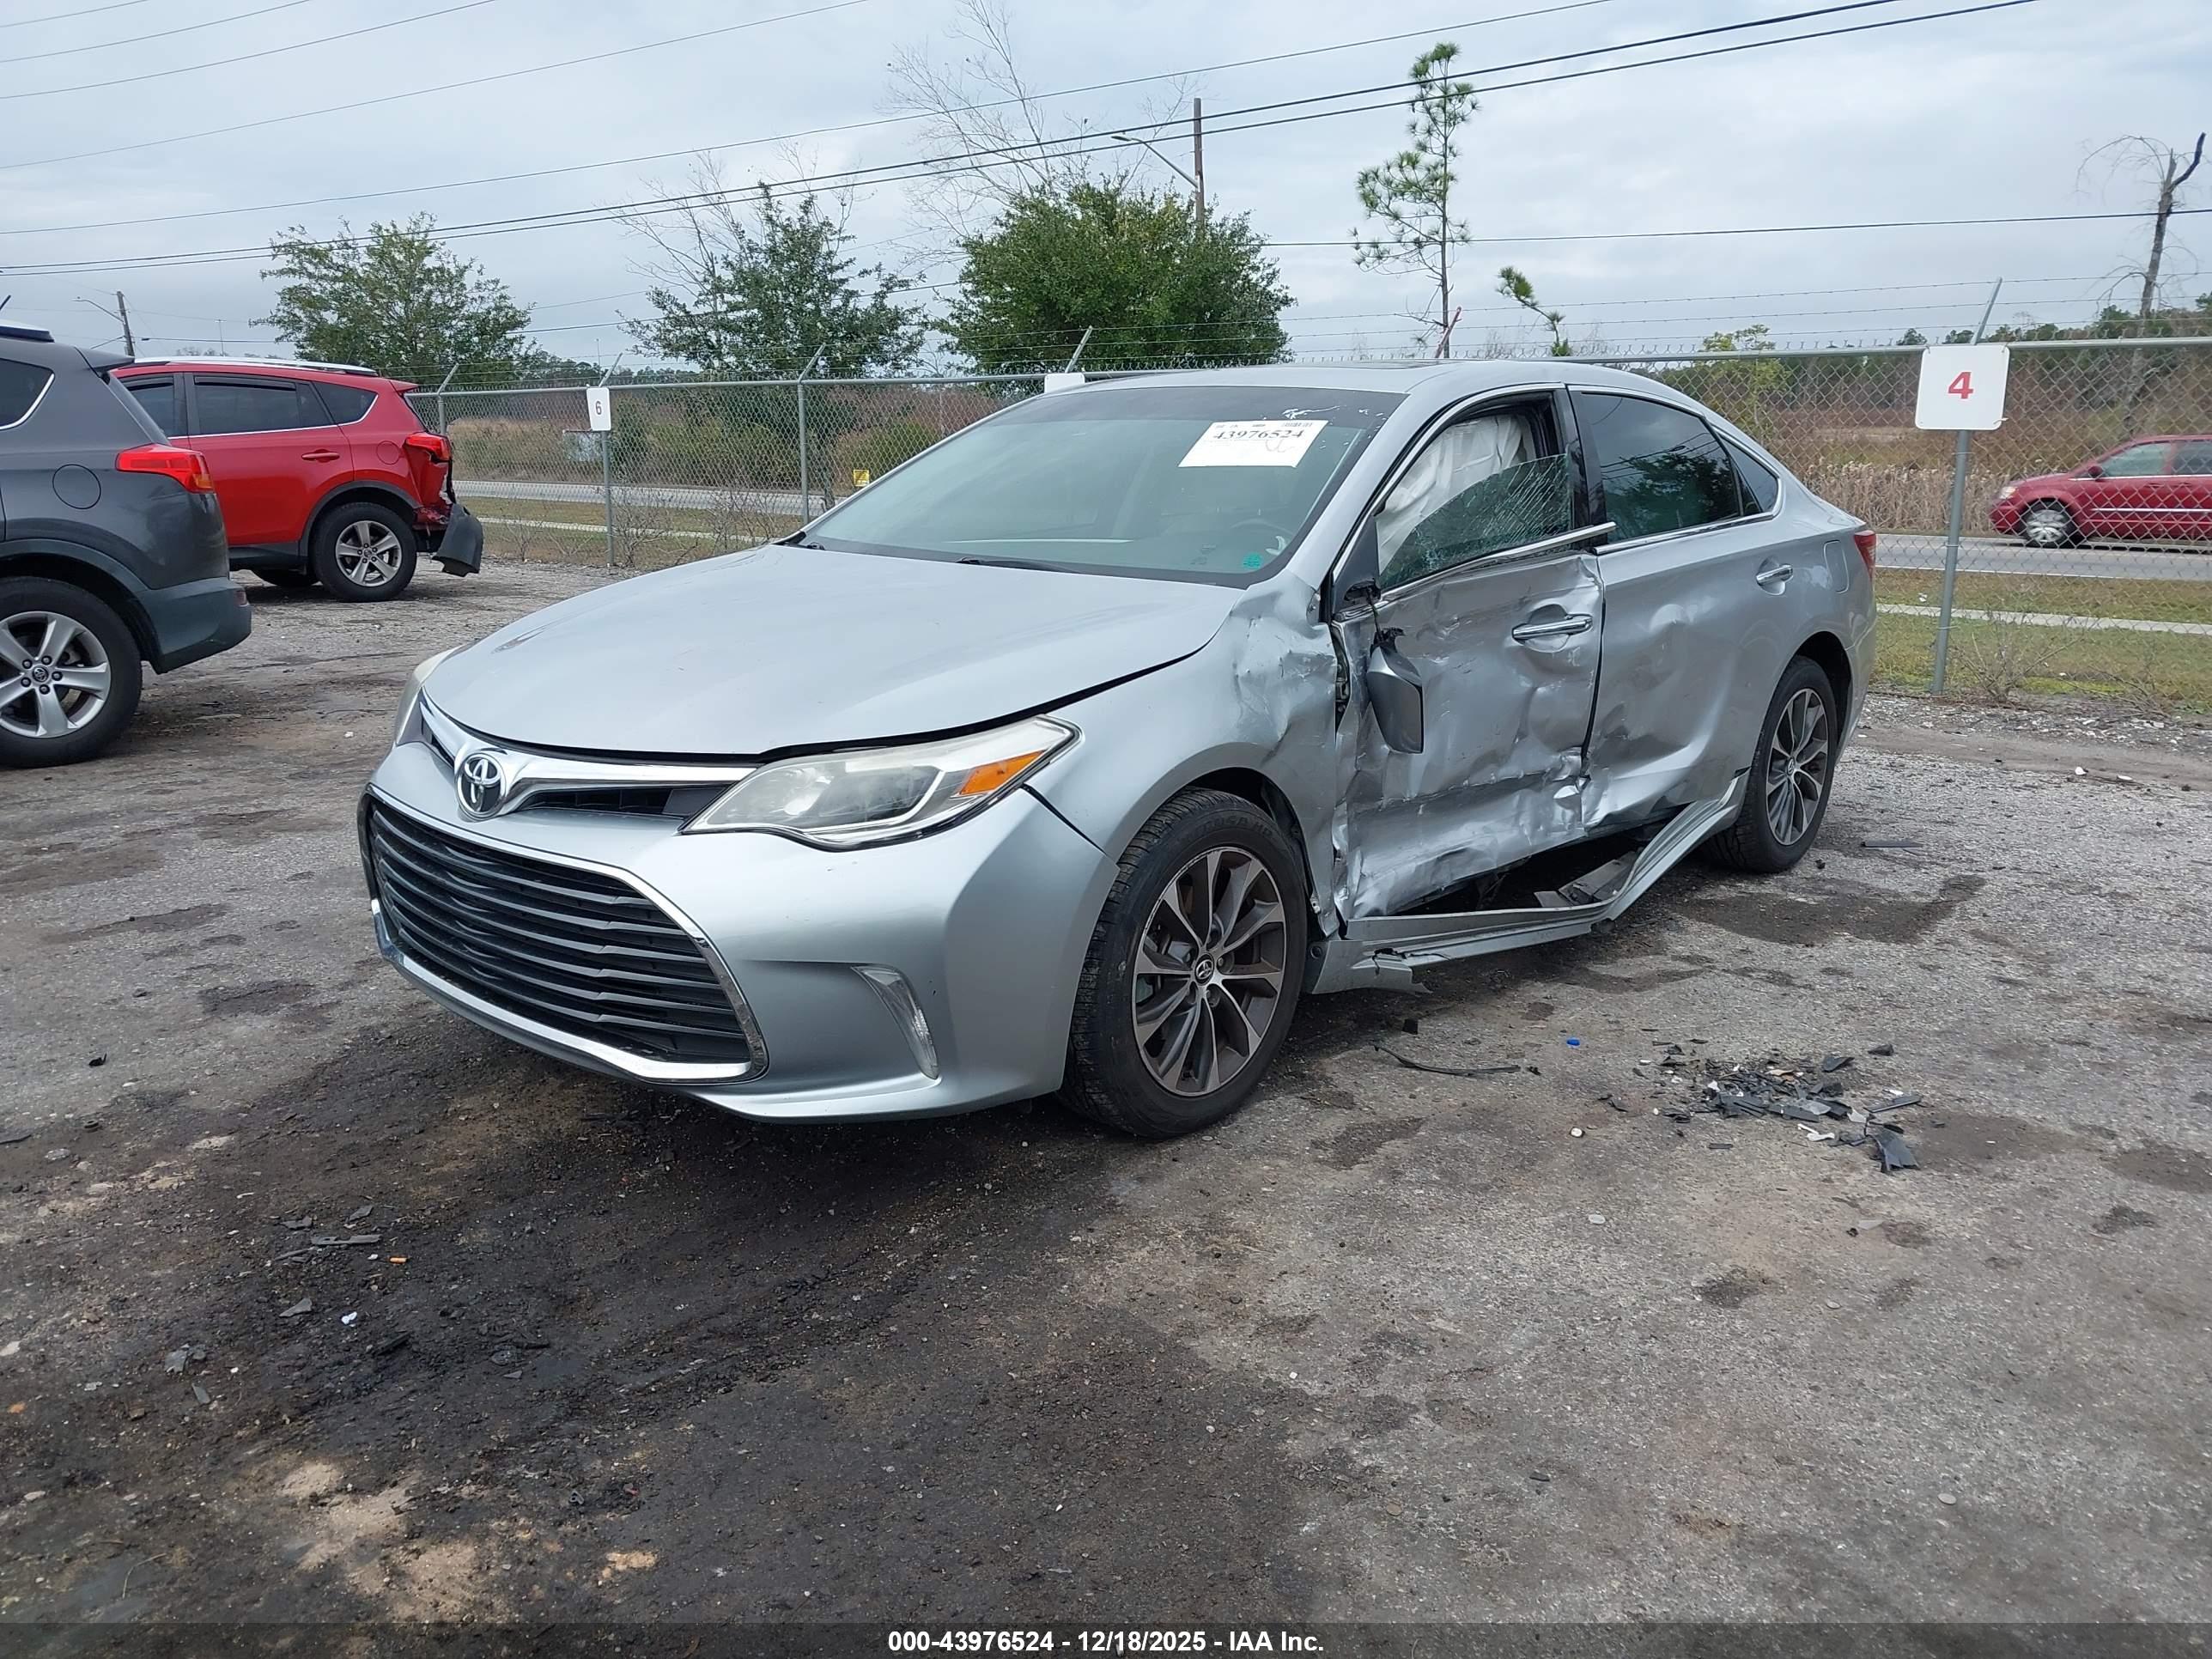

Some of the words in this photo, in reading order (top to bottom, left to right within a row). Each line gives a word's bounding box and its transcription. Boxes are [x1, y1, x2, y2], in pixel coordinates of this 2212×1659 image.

[1948, 371, 1974, 399] 4
[595, 400, 603, 416] 6
[1212, 429, 1305, 440] 43976524
